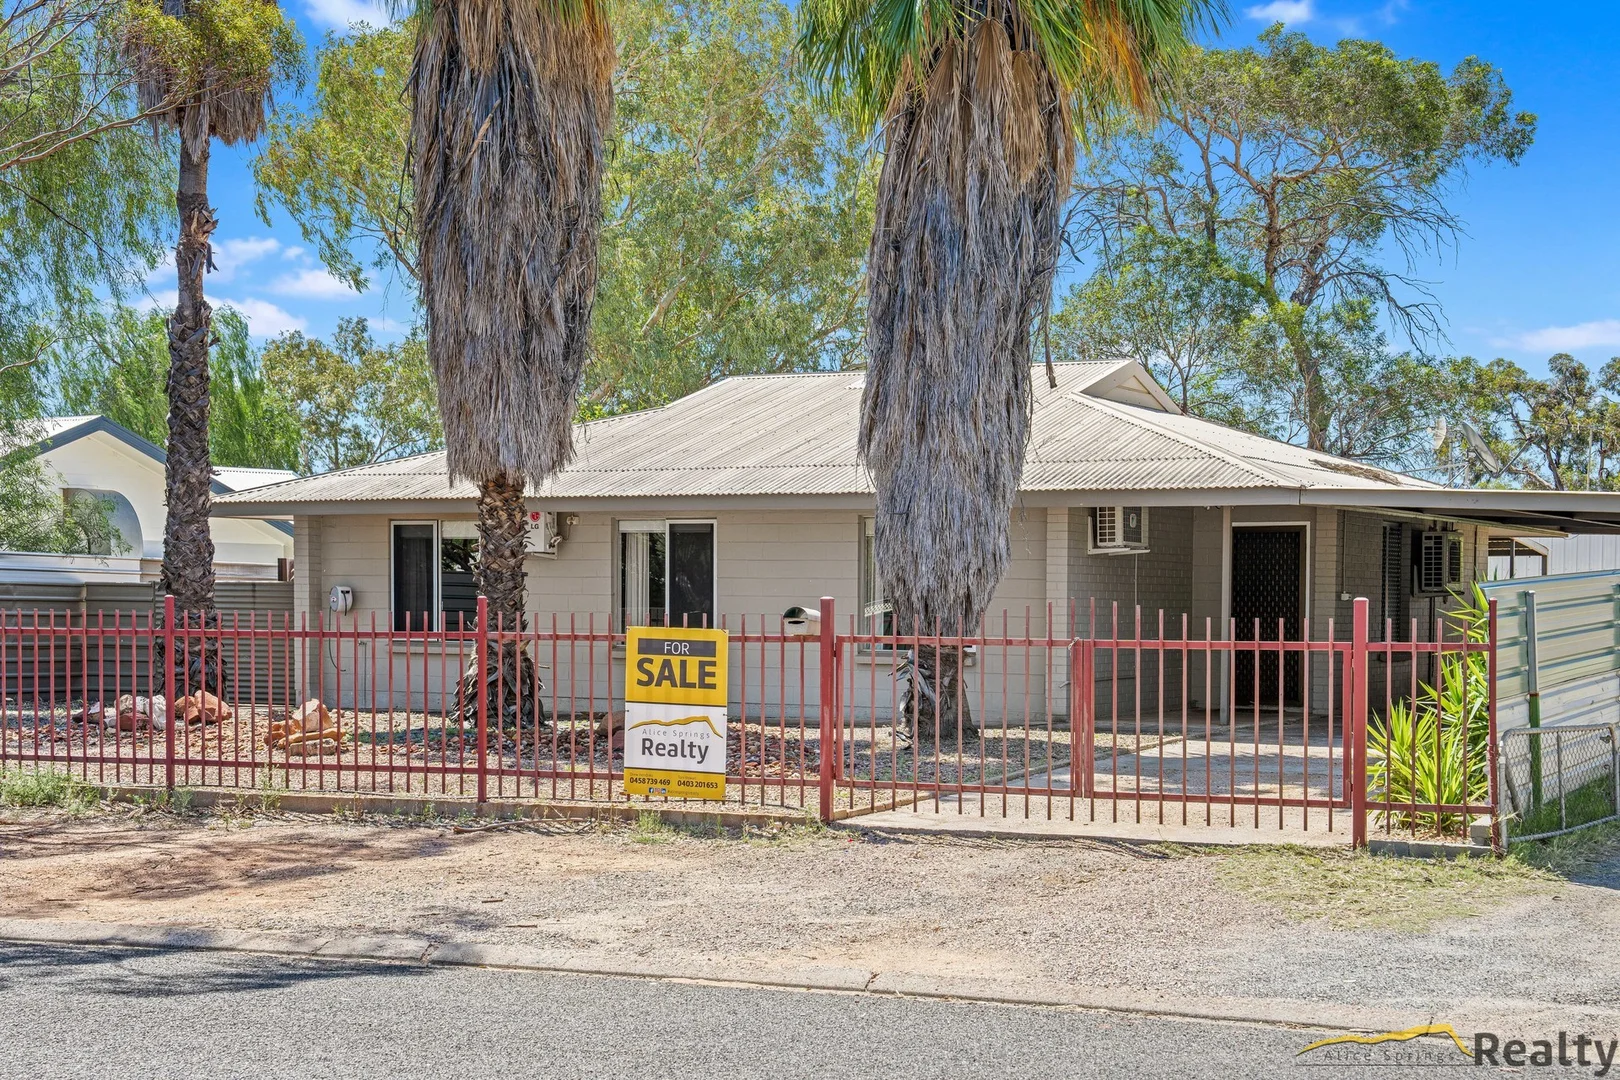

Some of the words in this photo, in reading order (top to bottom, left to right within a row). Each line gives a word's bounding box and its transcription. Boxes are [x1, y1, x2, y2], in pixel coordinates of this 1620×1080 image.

[664, 641, 690, 655] FOR
[636, 657, 717, 690] SALE
[642, 728, 667, 737] Alice
[672, 729, 710, 740] Springs
[641, 737, 709, 764] Realty
[629, 777, 646, 785] 0458
[677, 780, 694, 788] 0403
